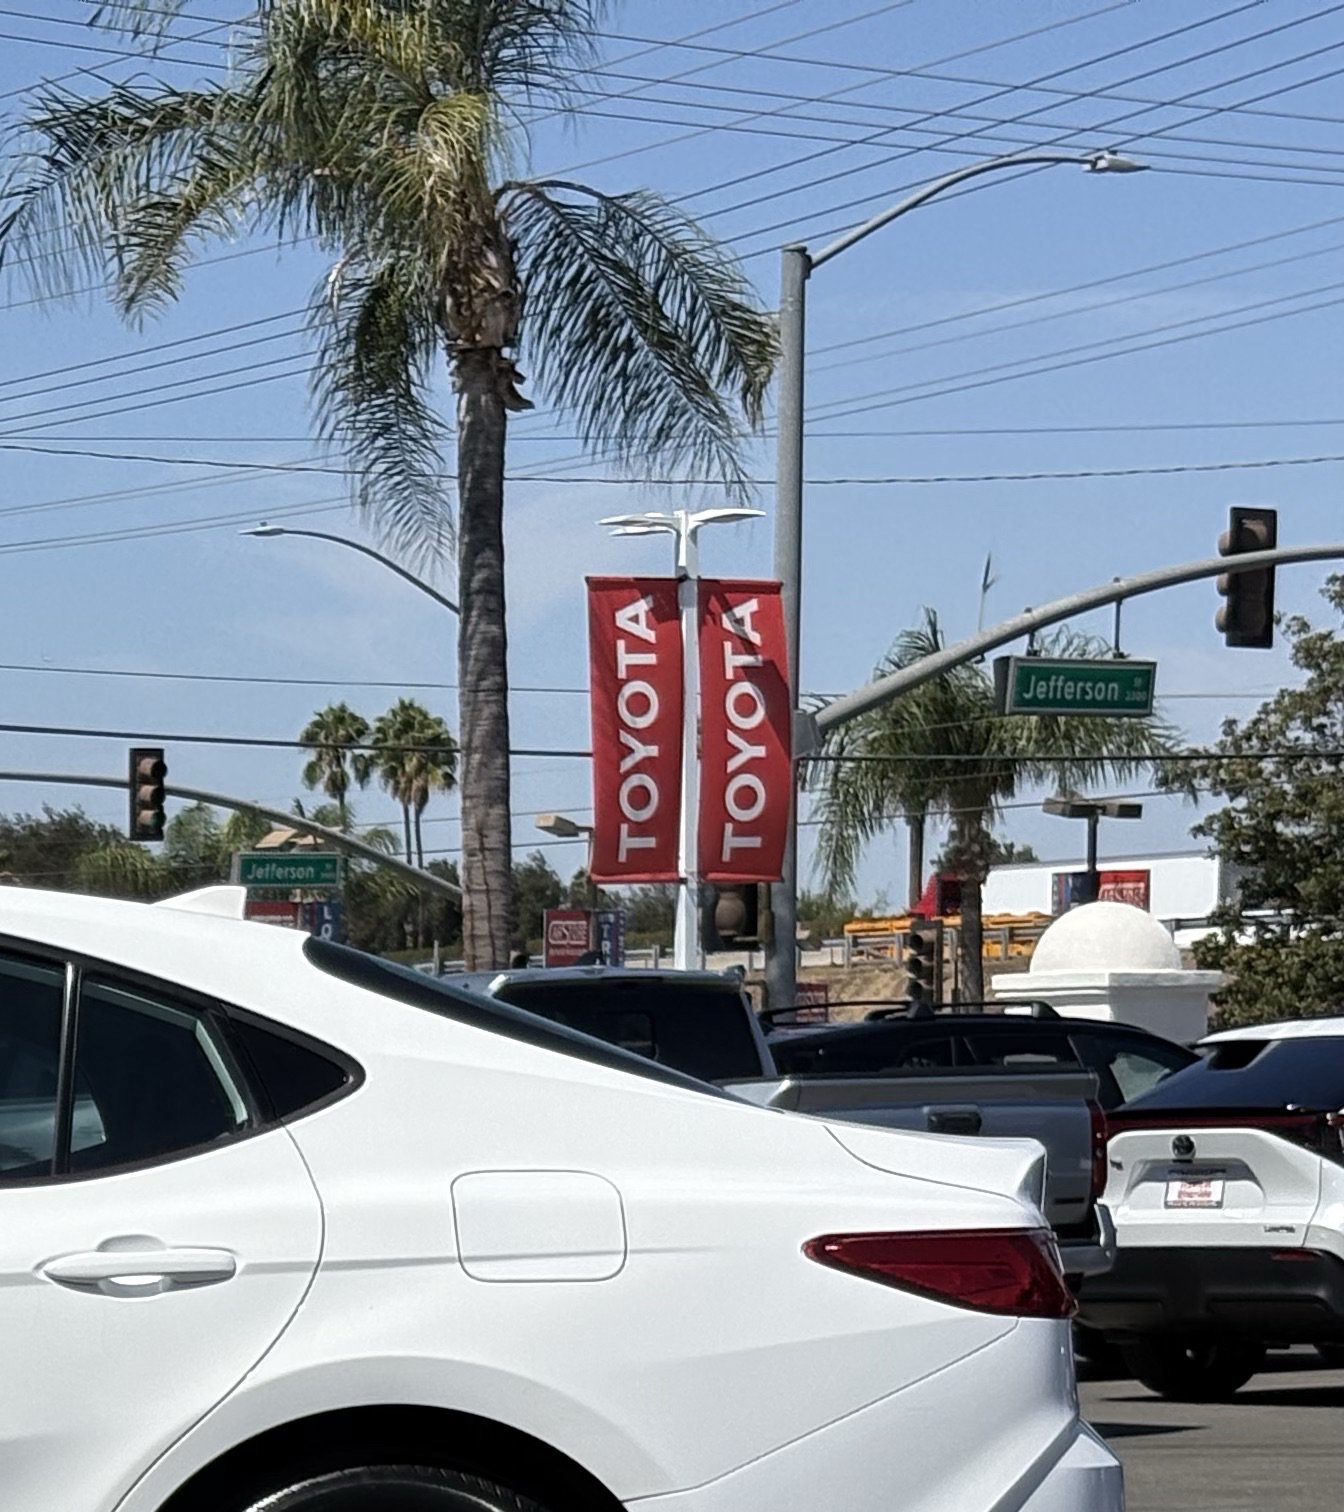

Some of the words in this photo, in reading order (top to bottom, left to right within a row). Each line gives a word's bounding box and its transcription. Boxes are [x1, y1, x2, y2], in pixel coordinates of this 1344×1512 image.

[615, 594, 659, 863] TOYOTA
[721, 598, 767, 863] TOYOTA
[1023, 675, 1119, 701] Jefferson
[247, 863, 315, 881] Jefferson
